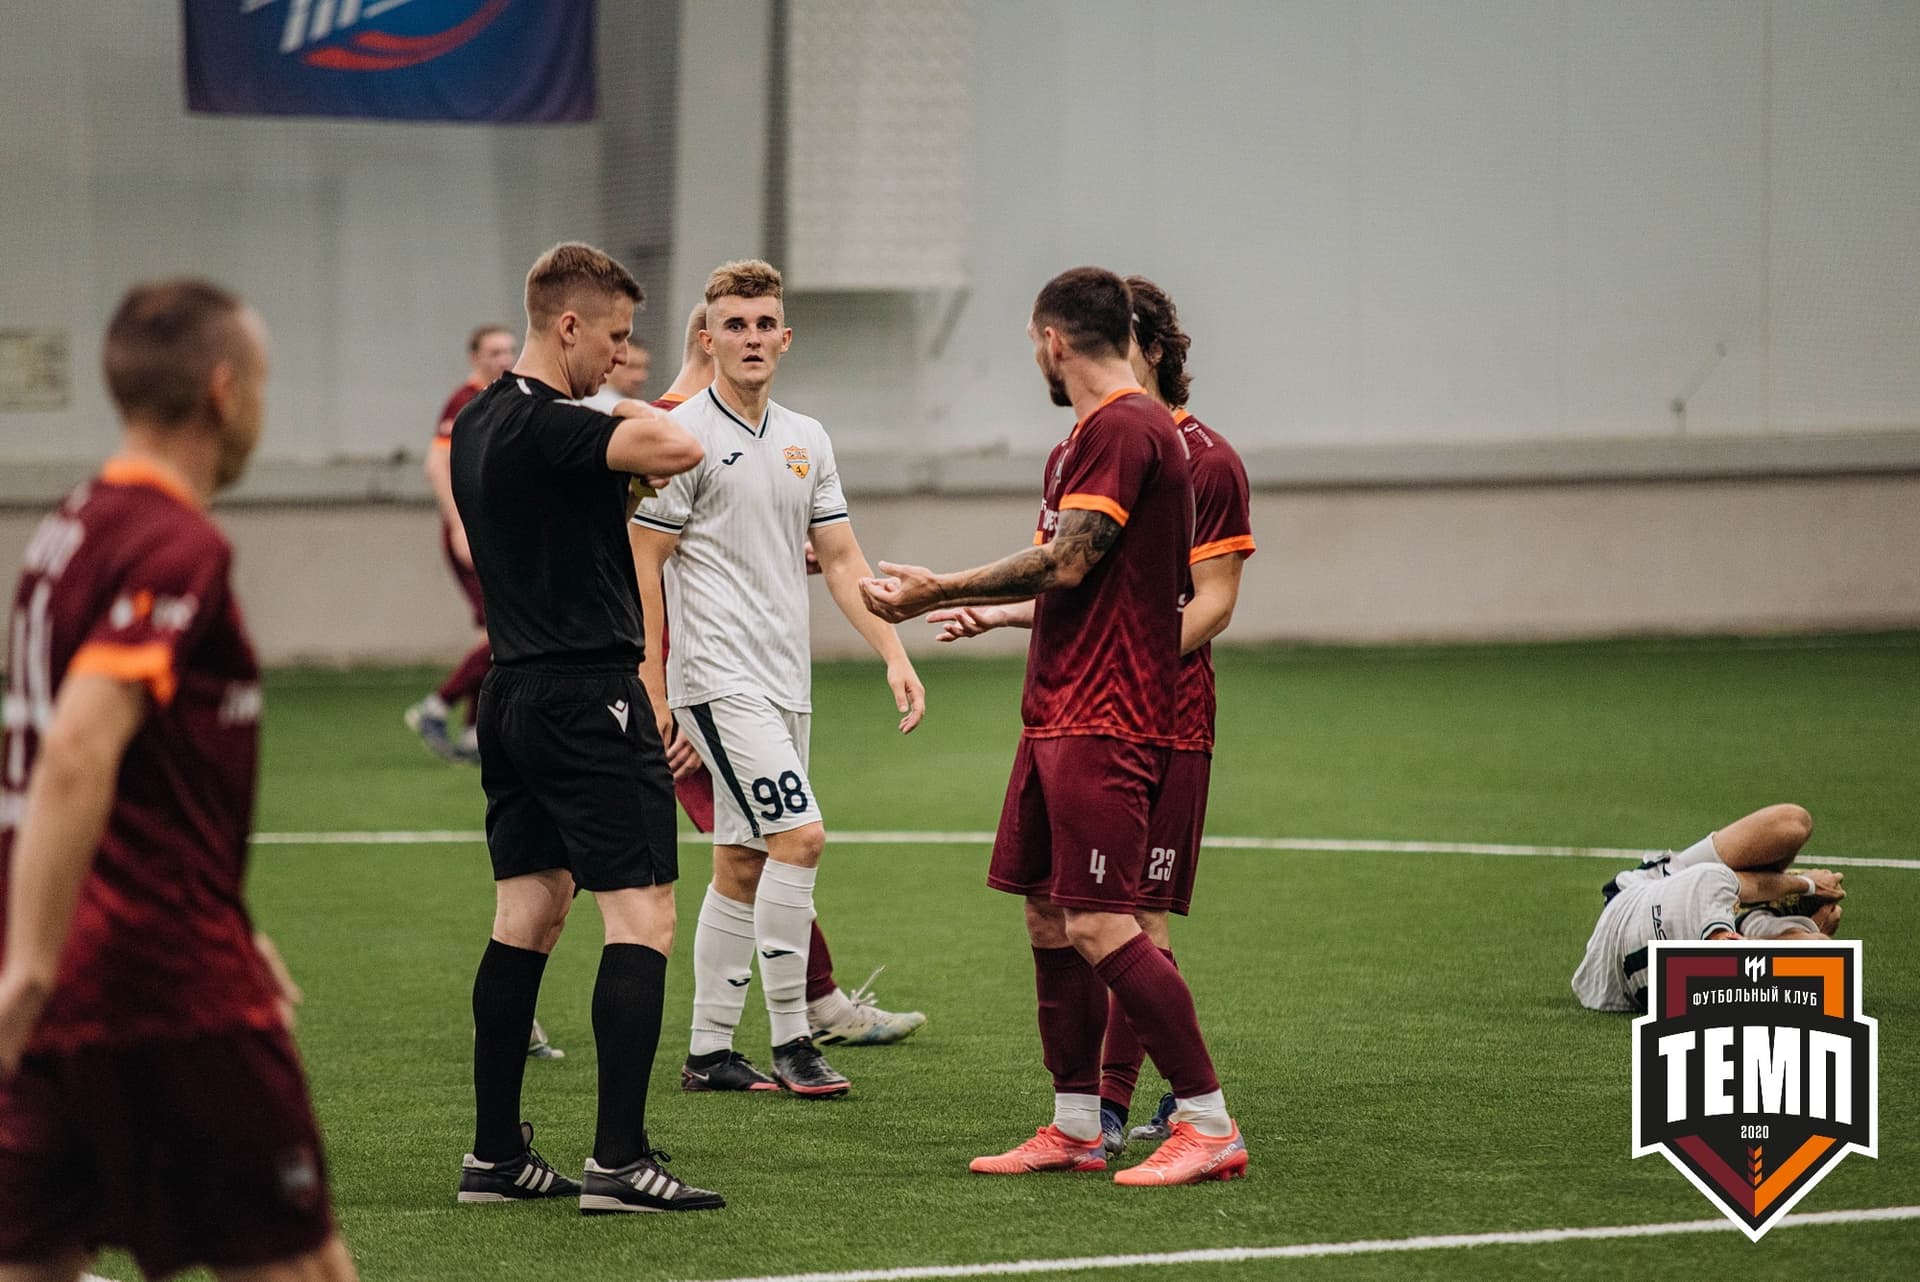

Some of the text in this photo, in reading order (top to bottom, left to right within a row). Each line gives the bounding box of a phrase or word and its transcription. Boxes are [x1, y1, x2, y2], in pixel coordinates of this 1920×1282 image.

[752, 770, 808, 821] 98
[1089, 849, 1106, 884] 4
[1148, 847, 1176, 881] 23
